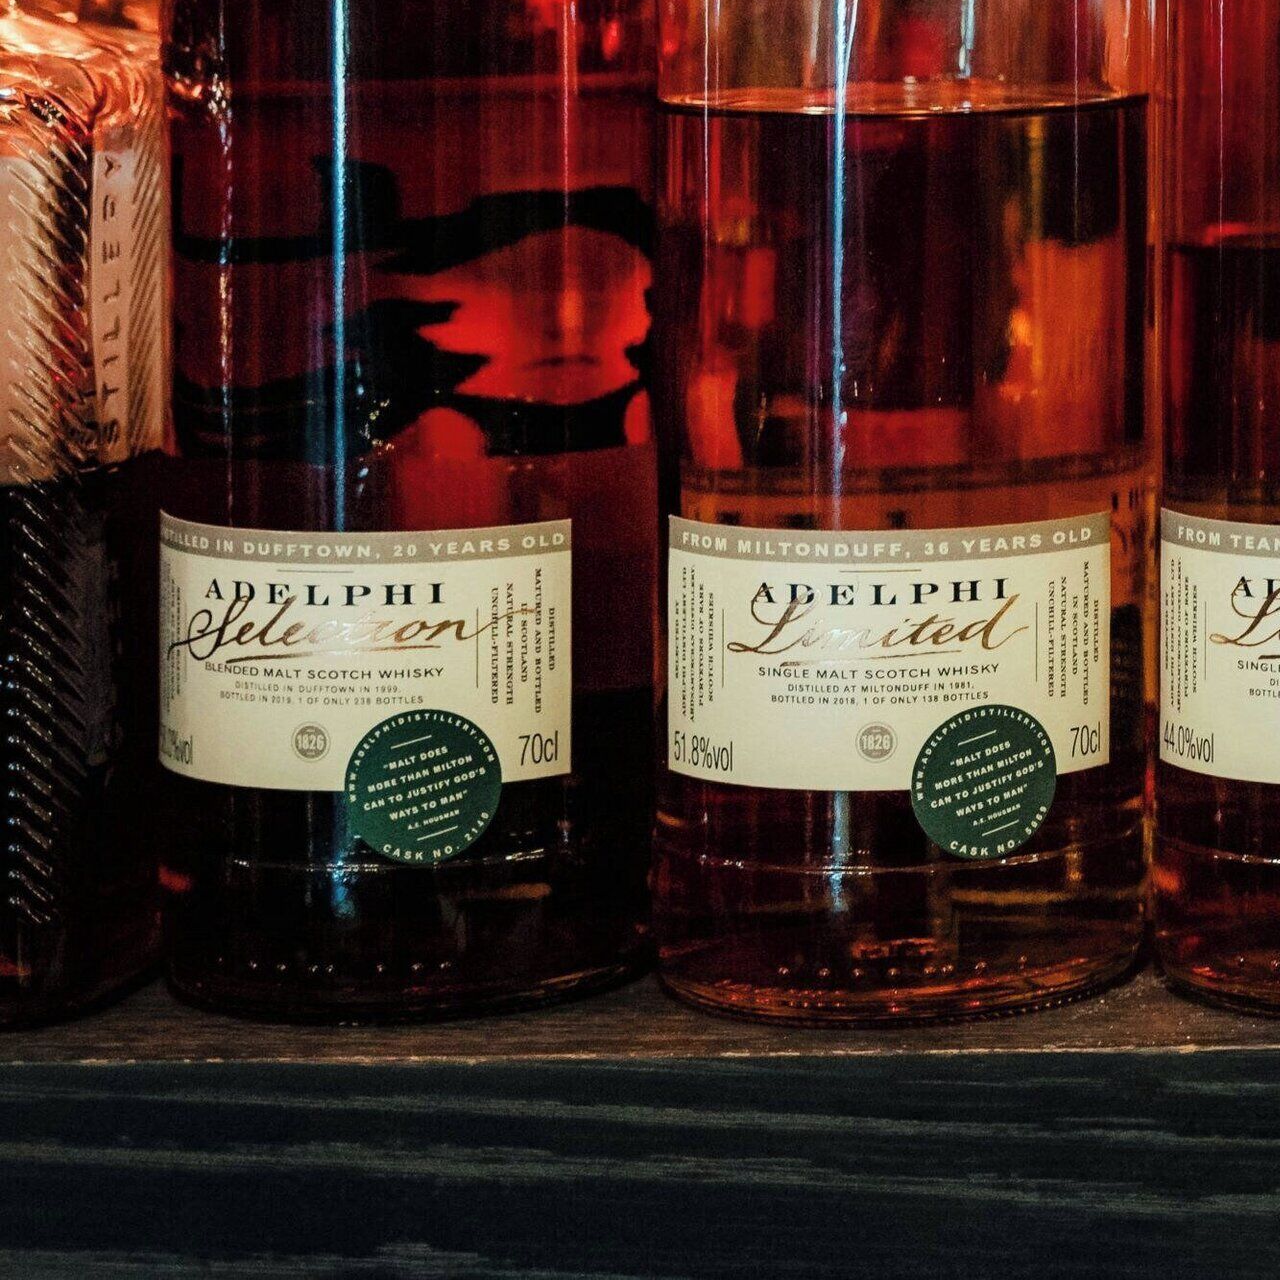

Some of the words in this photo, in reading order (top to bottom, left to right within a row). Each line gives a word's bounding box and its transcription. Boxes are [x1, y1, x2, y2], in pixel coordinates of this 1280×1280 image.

[217, 540, 233, 552] IN
[243, 541, 381, 560] DUFFTOWN,
[394, 544, 417, 556] 20
[429, 539, 513, 556] YEARS
[522, 533, 566, 549] OLD
[682, 532, 728, 552] FROM
[737, 539, 911, 560] MILTONDUFF,
[925, 542, 948, 555] 36
[962, 533, 1043, 553] YEARS
[1053, 528, 1091, 544] OLD
[1177, 526, 1221, 547] FROM
[205, 577, 445, 607] ADELPHI
[753, 577, 1010, 607] ADELPHI
[169, 593, 537, 660] Selection
[726, 593, 1030, 655] Limited
[759, 667, 808, 678] SINGLE
[817, 670, 857, 679] MALT
[865, 668, 930, 679] SCOTCH
[938, 664, 998, 676] WHISKY
[519, 730, 558, 766] 70cl
[674, 731, 732, 771] 51.8%vol
[1071, 722, 1100, 757] 70cl
[1164, 721, 1213, 762] 44.0%vol
